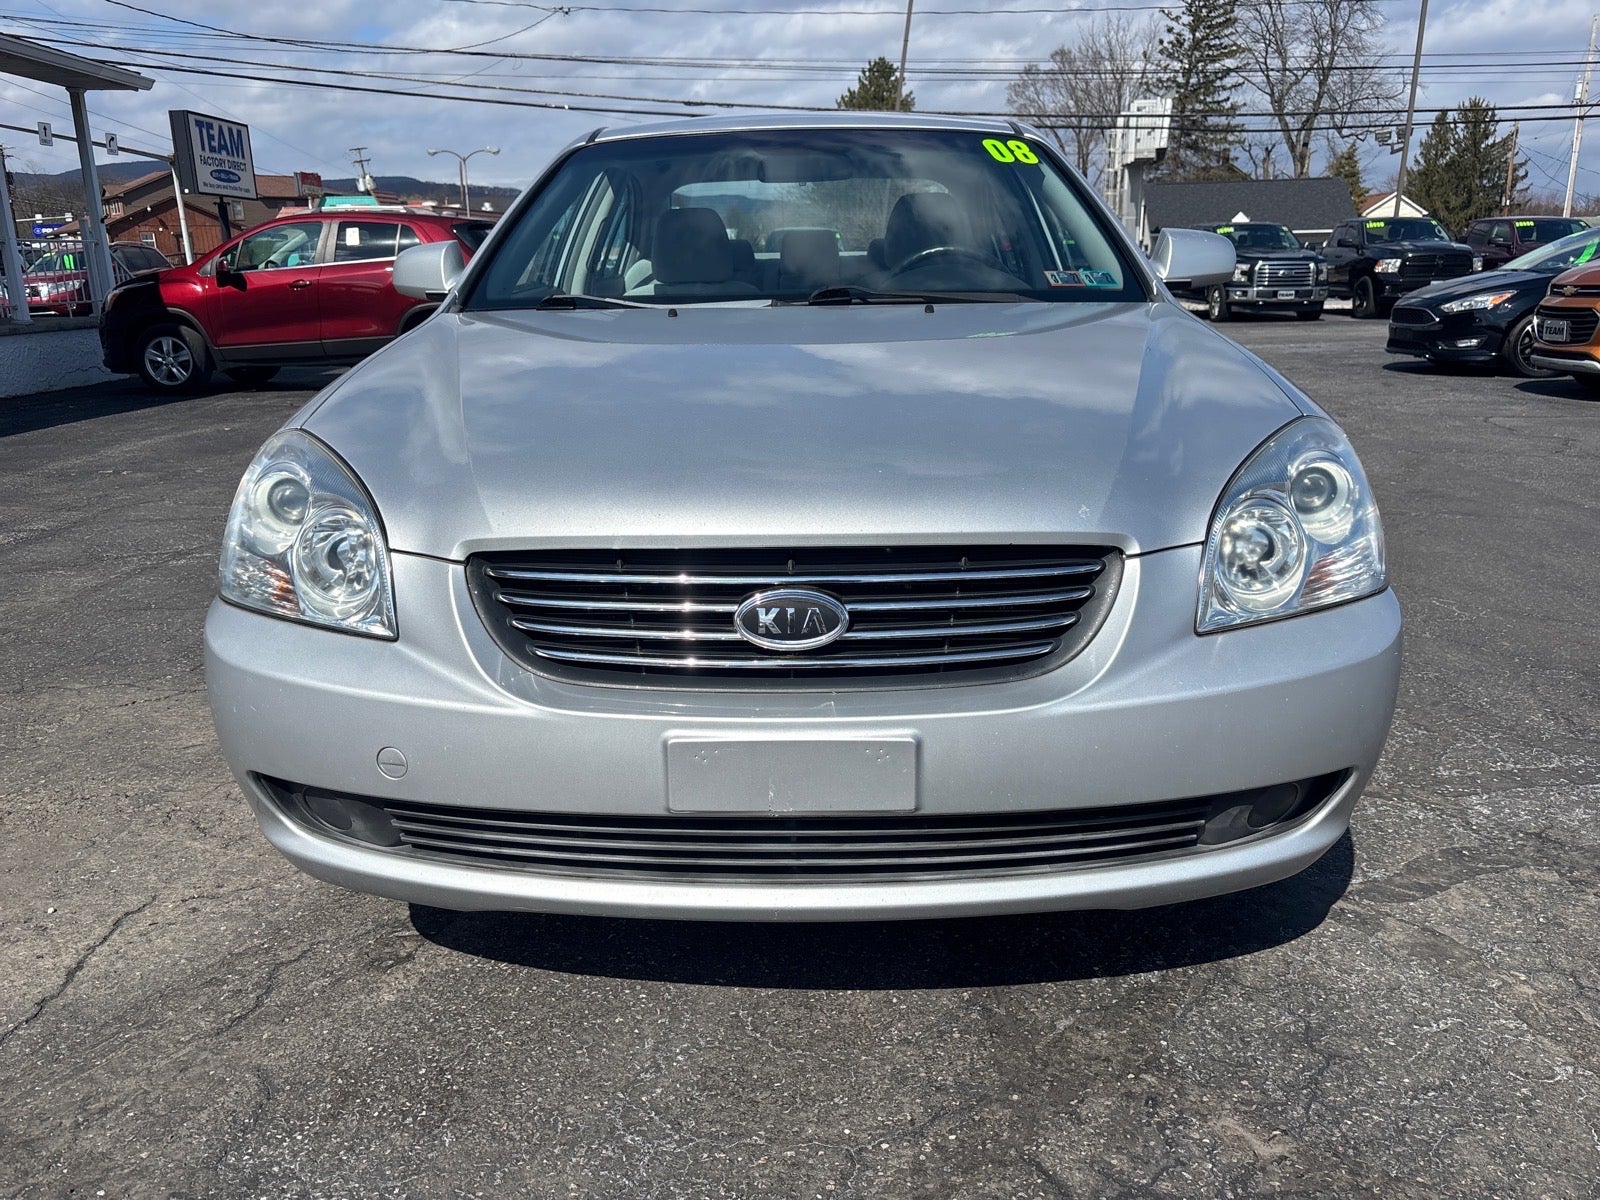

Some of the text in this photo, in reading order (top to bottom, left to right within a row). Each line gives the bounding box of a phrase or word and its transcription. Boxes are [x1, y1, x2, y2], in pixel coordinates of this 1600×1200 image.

[195, 119, 245, 159] TEAM
[982, 139, 1039, 165] 08
[200, 155, 246, 172] FACTORY DIRECT
[1545, 326, 1564, 335] TEAM
[756, 607, 828, 634] KIA
